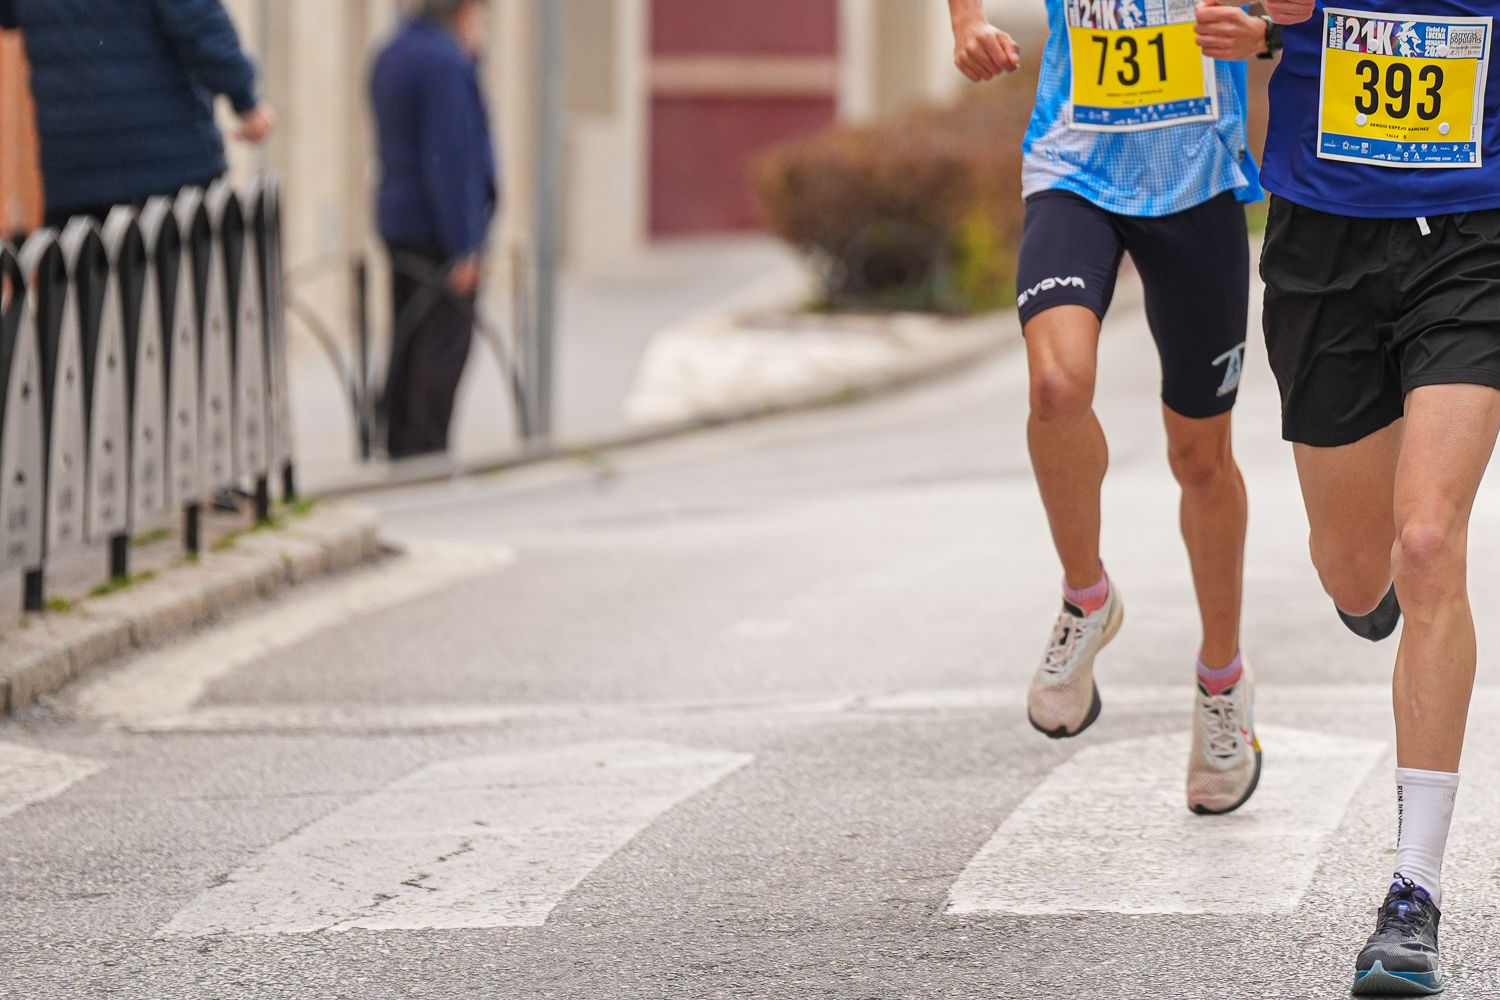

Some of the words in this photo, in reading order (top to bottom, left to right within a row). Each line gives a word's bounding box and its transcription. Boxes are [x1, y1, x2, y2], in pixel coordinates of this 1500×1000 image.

[1345, 17, 1394, 56] 21K
[1449, 37, 1482, 46] populares
[1450, 32, 1478, 40] carreras
[1091, 32, 1168, 87] 731
[1354, 59, 1445, 121] 393
